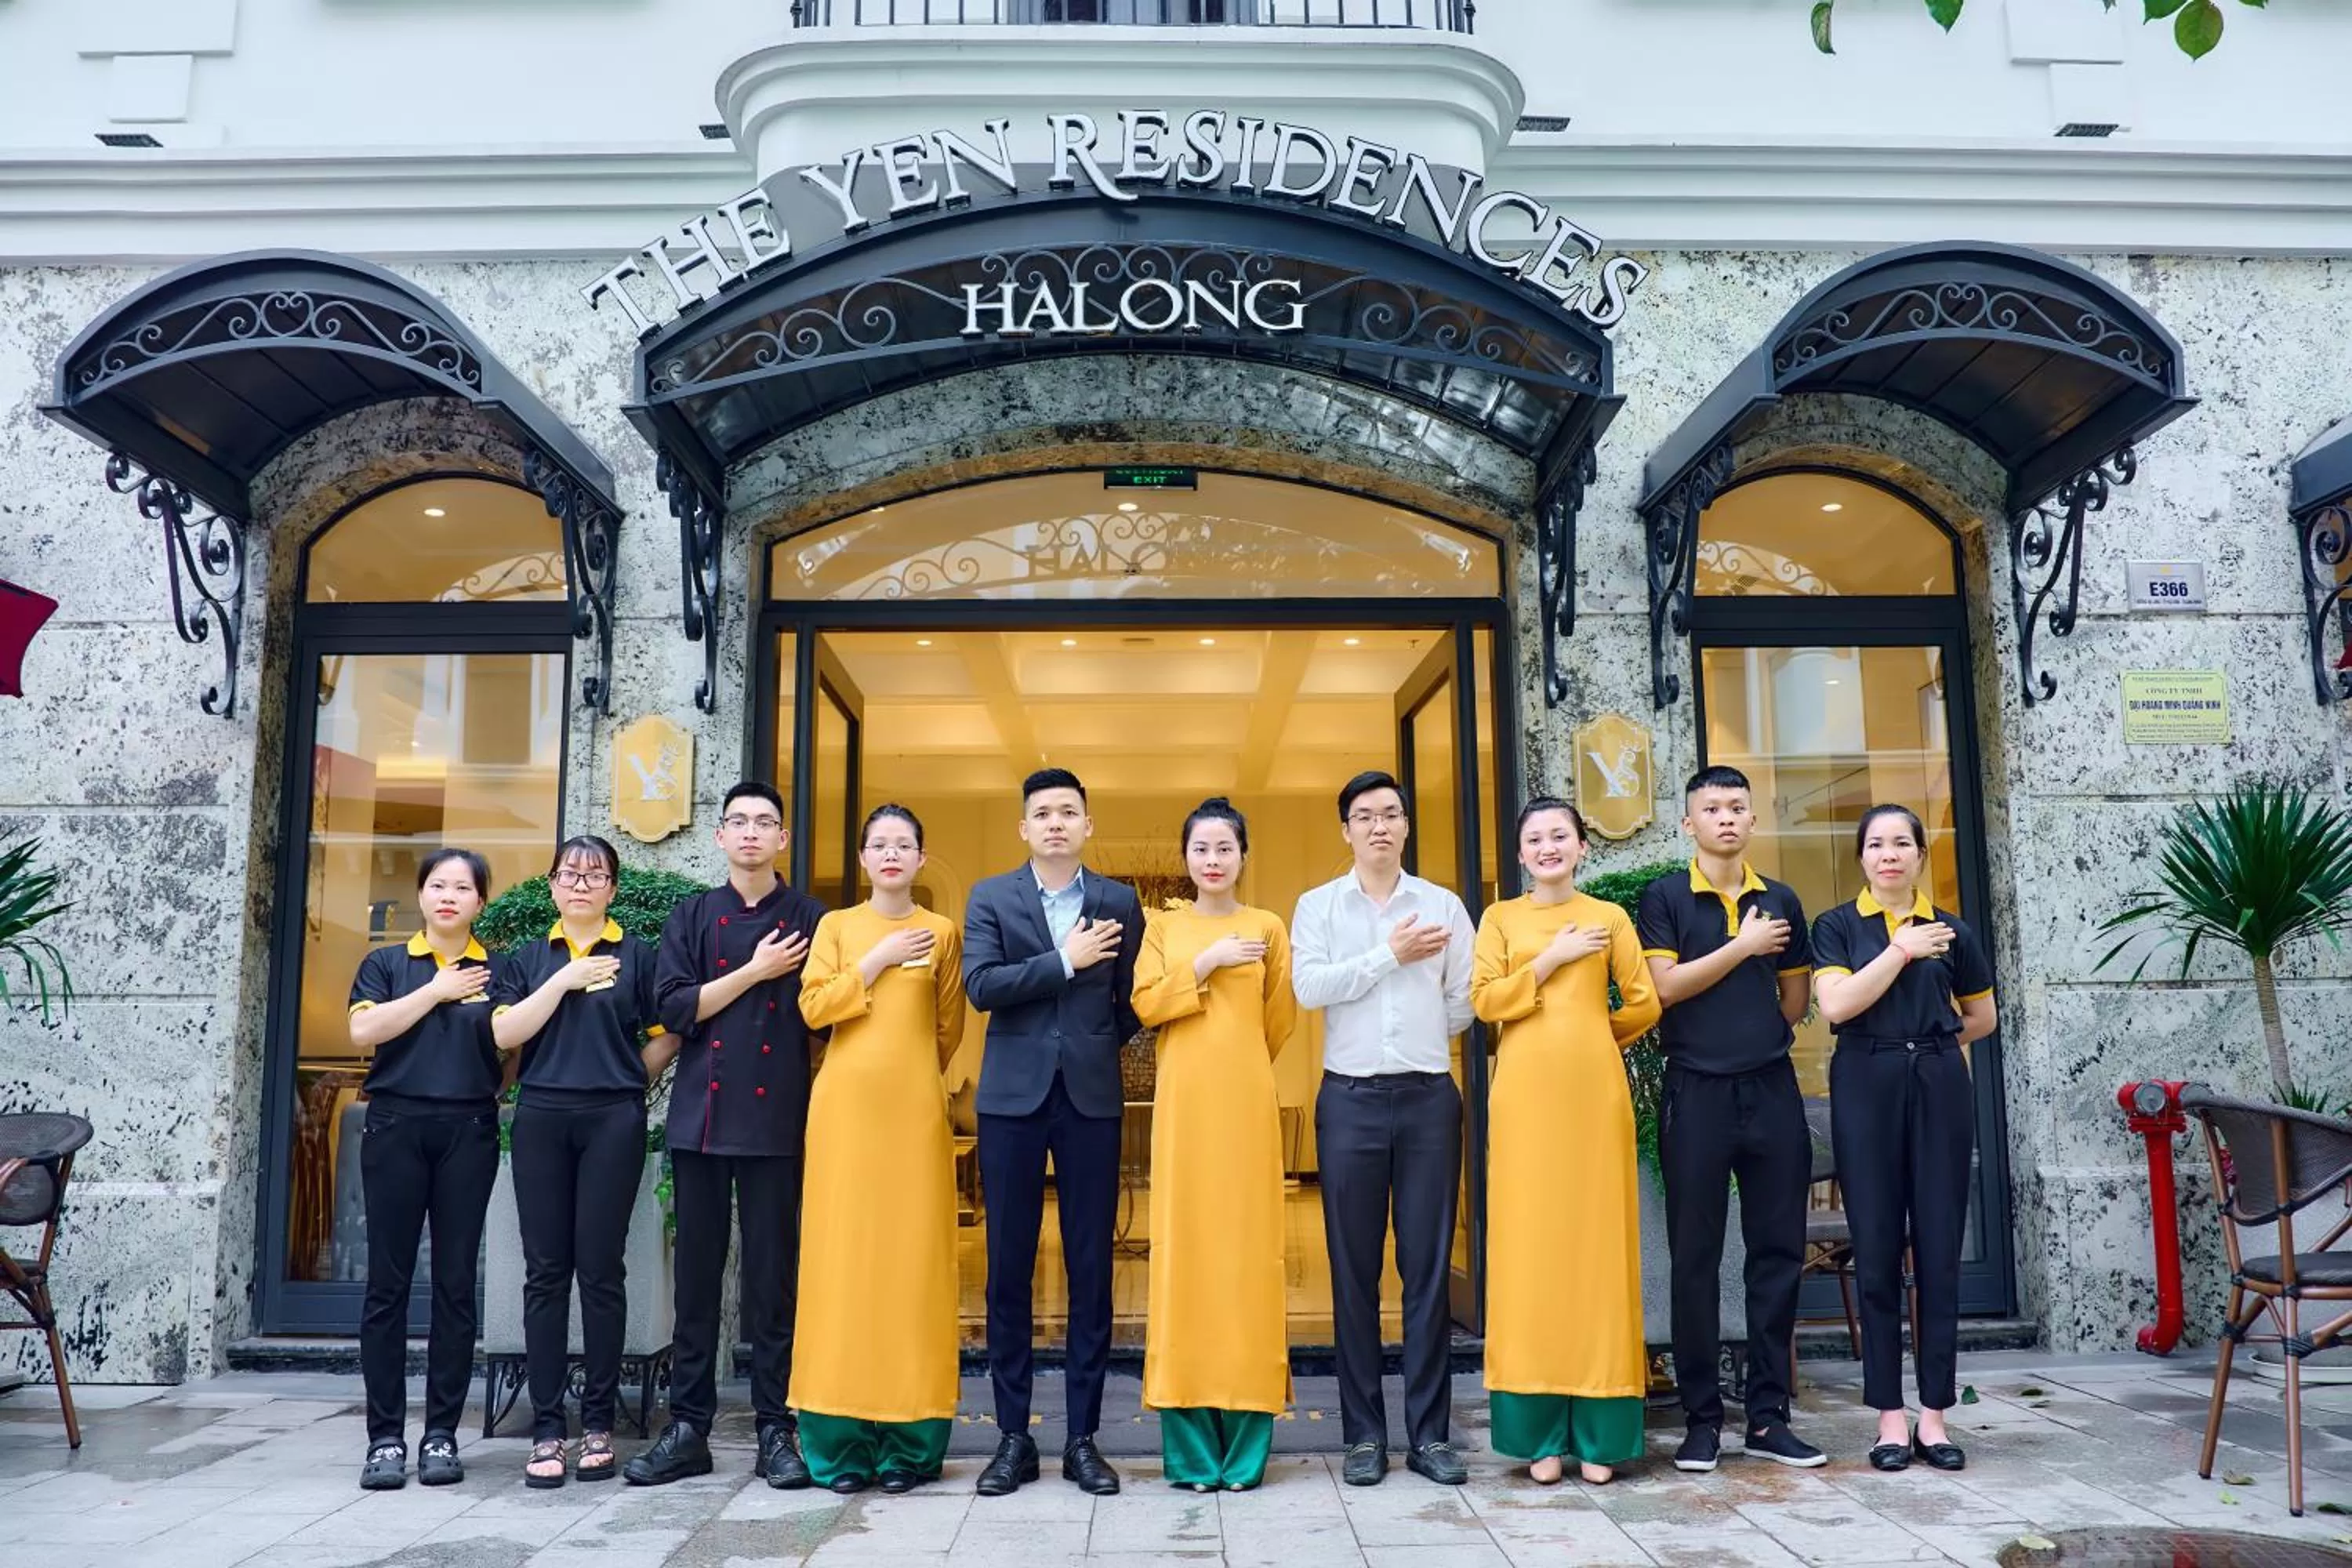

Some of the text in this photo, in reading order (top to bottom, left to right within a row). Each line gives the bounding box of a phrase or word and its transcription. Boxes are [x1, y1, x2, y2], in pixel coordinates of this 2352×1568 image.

[579, 109, 1647, 339] THE YEN RESIDENCES
[959, 278, 1308, 339] HALONG
[2149, 582, 2189, 597] E366
